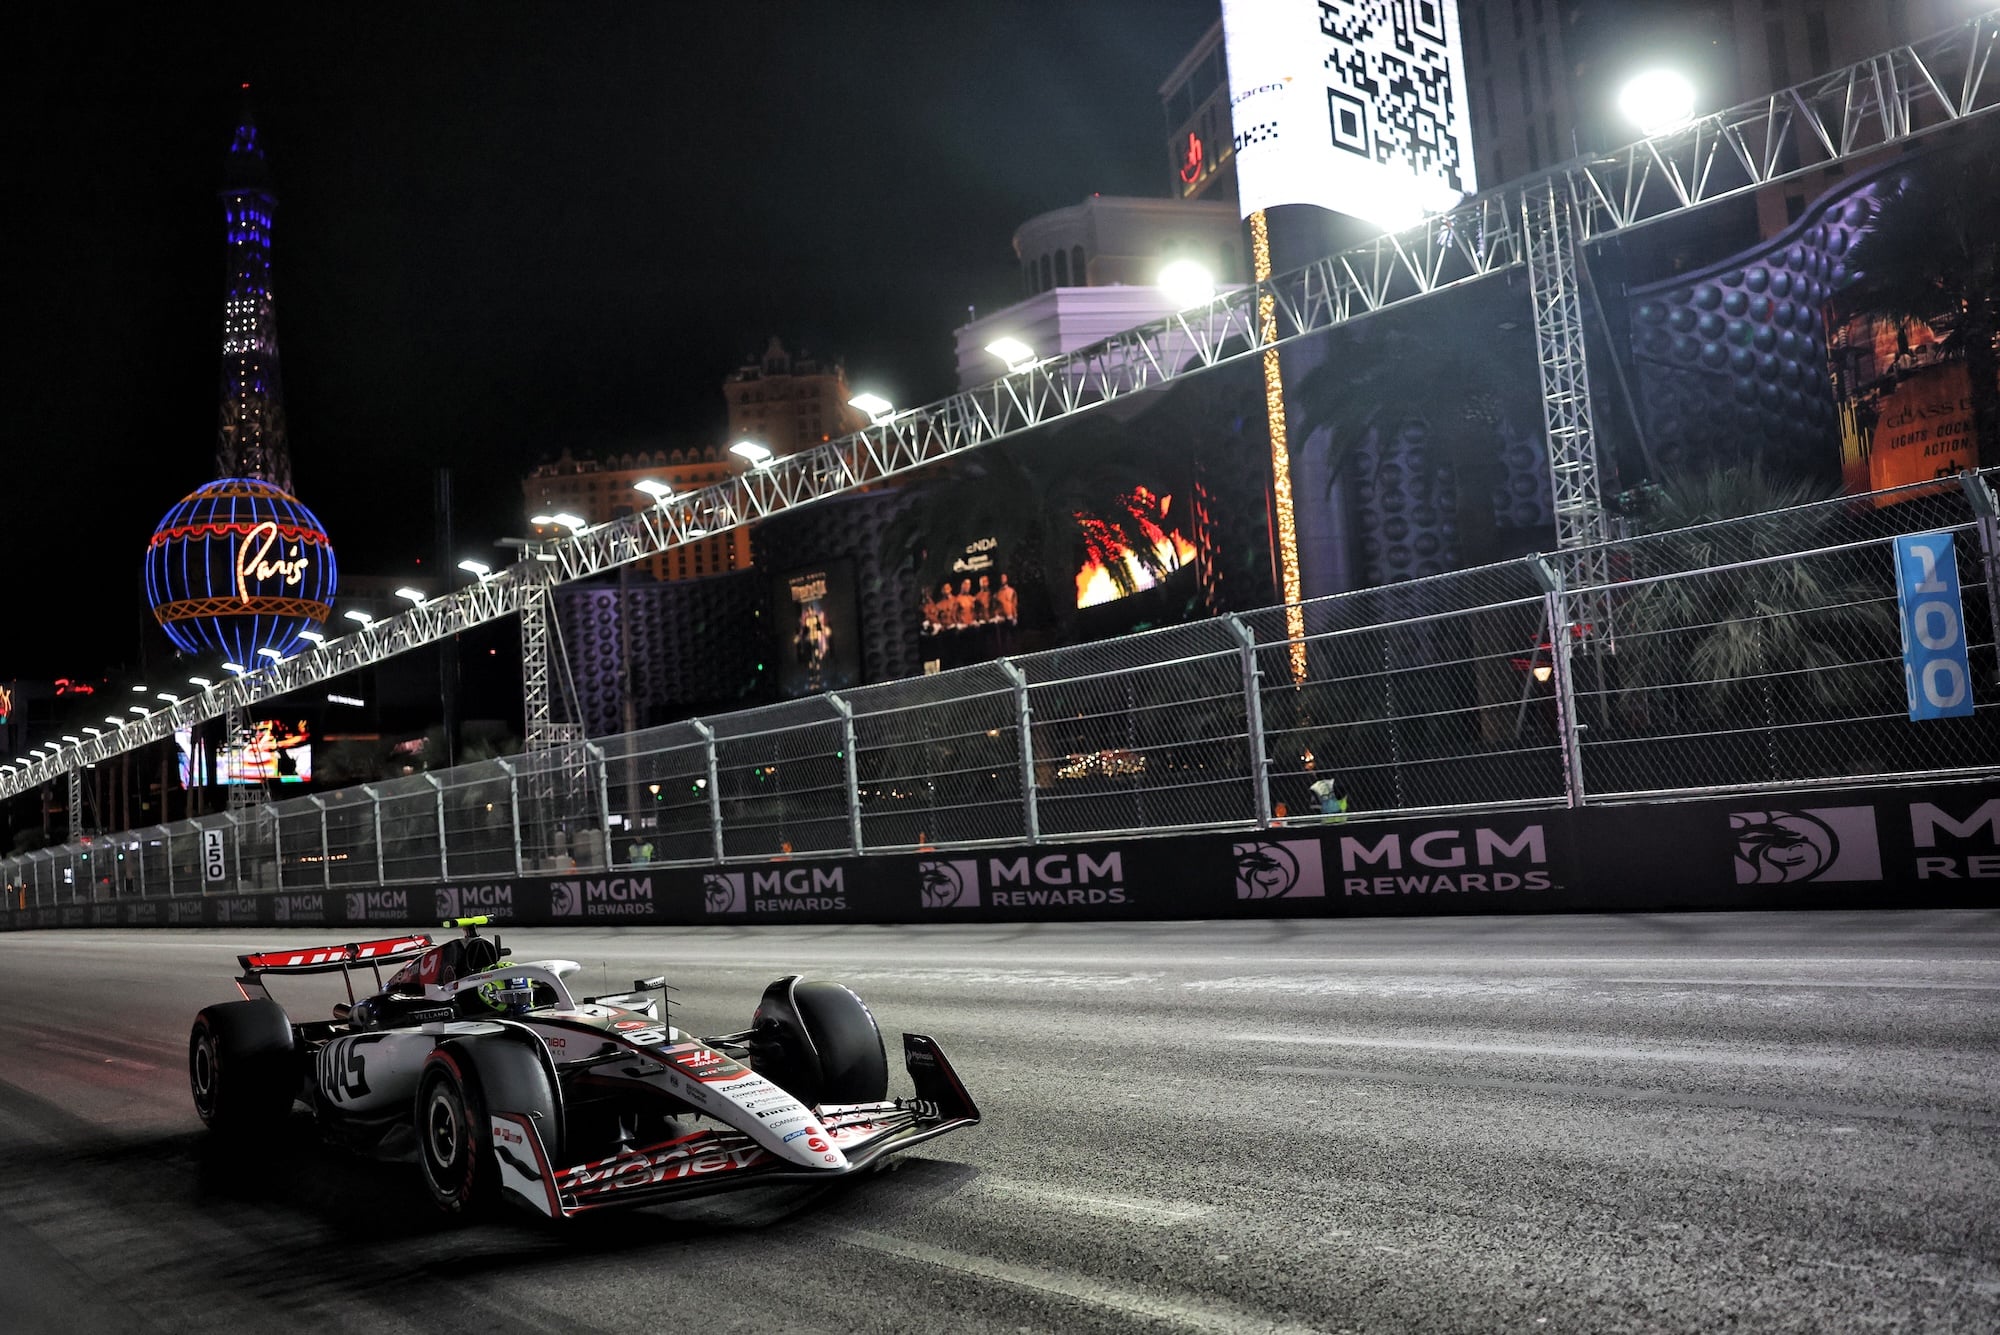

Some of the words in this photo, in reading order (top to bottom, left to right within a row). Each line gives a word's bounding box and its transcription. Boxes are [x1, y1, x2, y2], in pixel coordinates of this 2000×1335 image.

[1891, 430, 1928, 449] LIGHTS
[237, 521, 309, 604] Paris
[1910, 545, 1966, 708] 100
[209, 833, 222, 878] 150
[1340, 824, 1547, 872] MGM
[990, 852, 1124, 887] MGM
[586, 878, 652, 901] MGM
[752, 867, 845, 895] MGM
[1344, 871, 1551, 895] REWARDS
[291, 895, 323, 911] MGM
[368, 891, 408, 909] MGM
[462, 885, 512, 904] MGM
[754, 897, 847, 911] REWARDS
[993, 888, 1126, 906] REWARDS
[231, 900, 256, 913] MGM
[369, 910, 408, 920] REWARDS
[587, 903, 655, 915] REWARDS
[415, 1011, 450, 1020] VELLAMO
